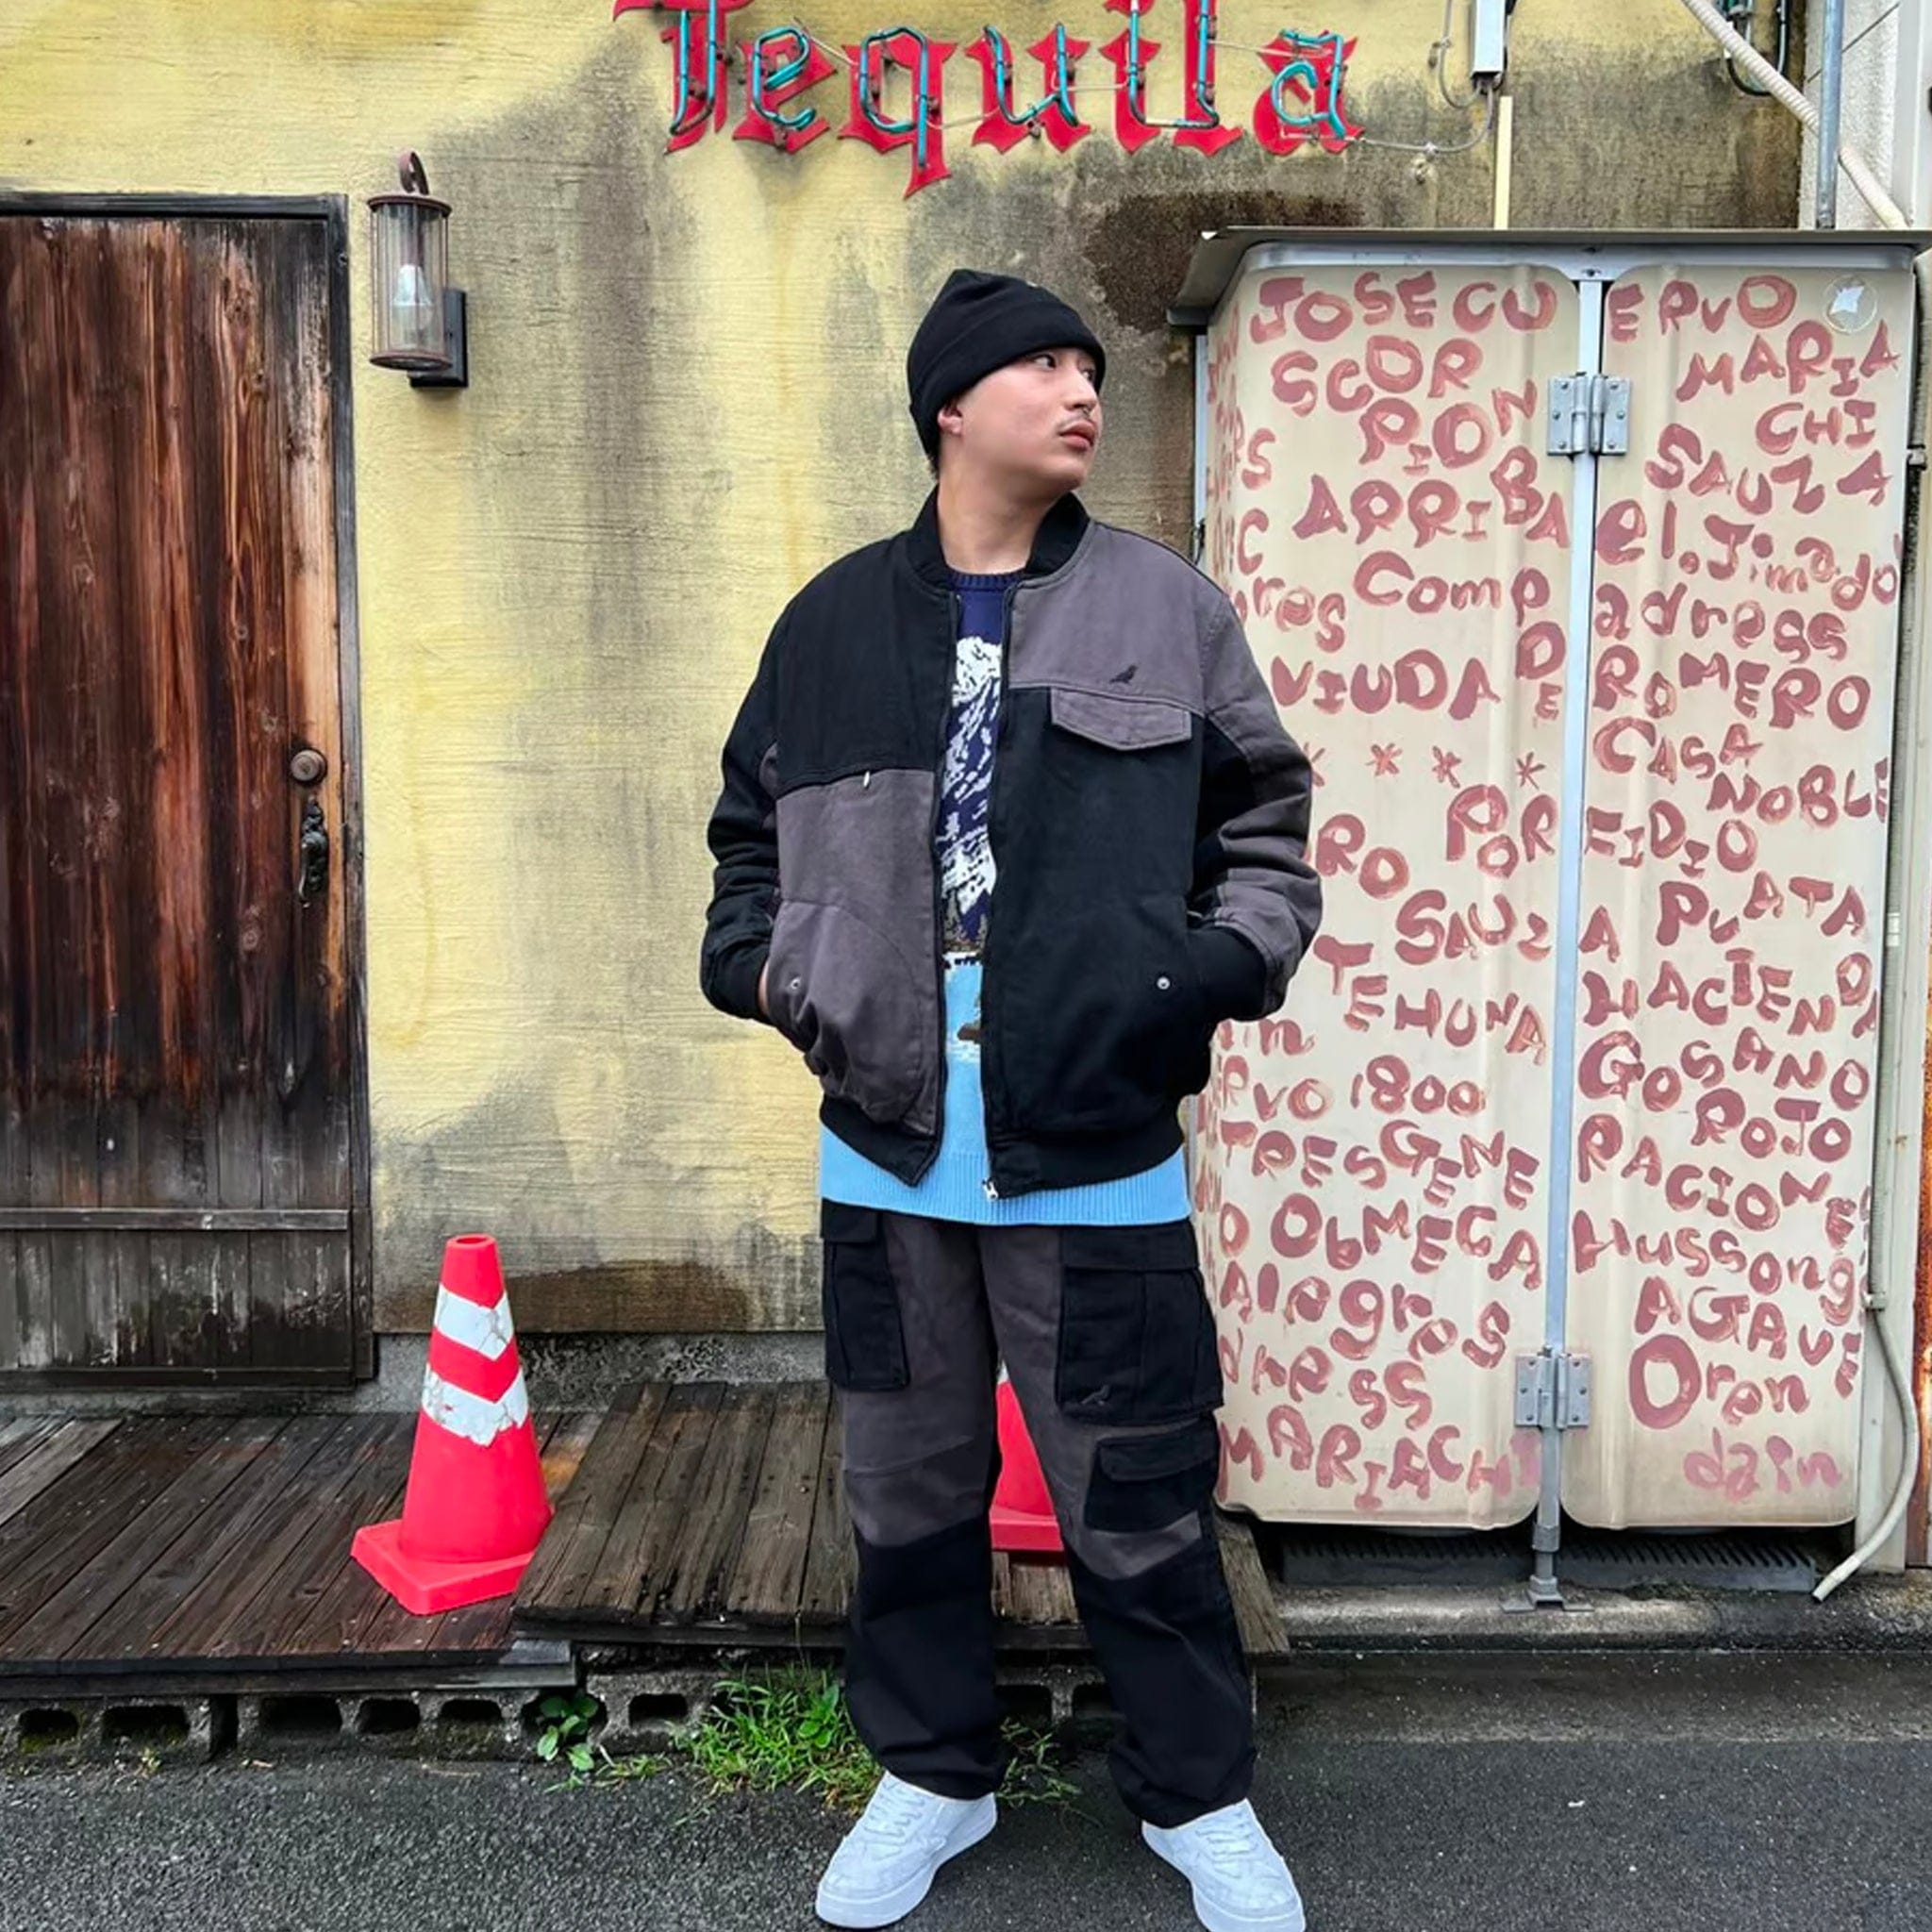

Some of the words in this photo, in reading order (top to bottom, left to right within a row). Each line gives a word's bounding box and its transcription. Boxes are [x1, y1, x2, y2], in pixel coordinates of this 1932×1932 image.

[613, 0, 1366, 198] Tequila
[1271, 335, 1483, 417] SCOR
[1676, 320, 1900, 403] MARIA
[1756, 399, 1876, 456] CHI
[1292, 445, 1570, 548] ARRIBA
[1645, 424, 1892, 515] SAUZA
[1271, 648, 1501, 721] VIUDA
[1592, 643, 1871, 731] ROMERO
[1593, 715, 1763, 785] CASA
[1707, 757, 1888, 828] NOBLE
[1306, 813, 1409, 899] RO
[1350, 1055, 1486, 1117] 1800
[1634, 1275, 1861, 1398] AGAVE
